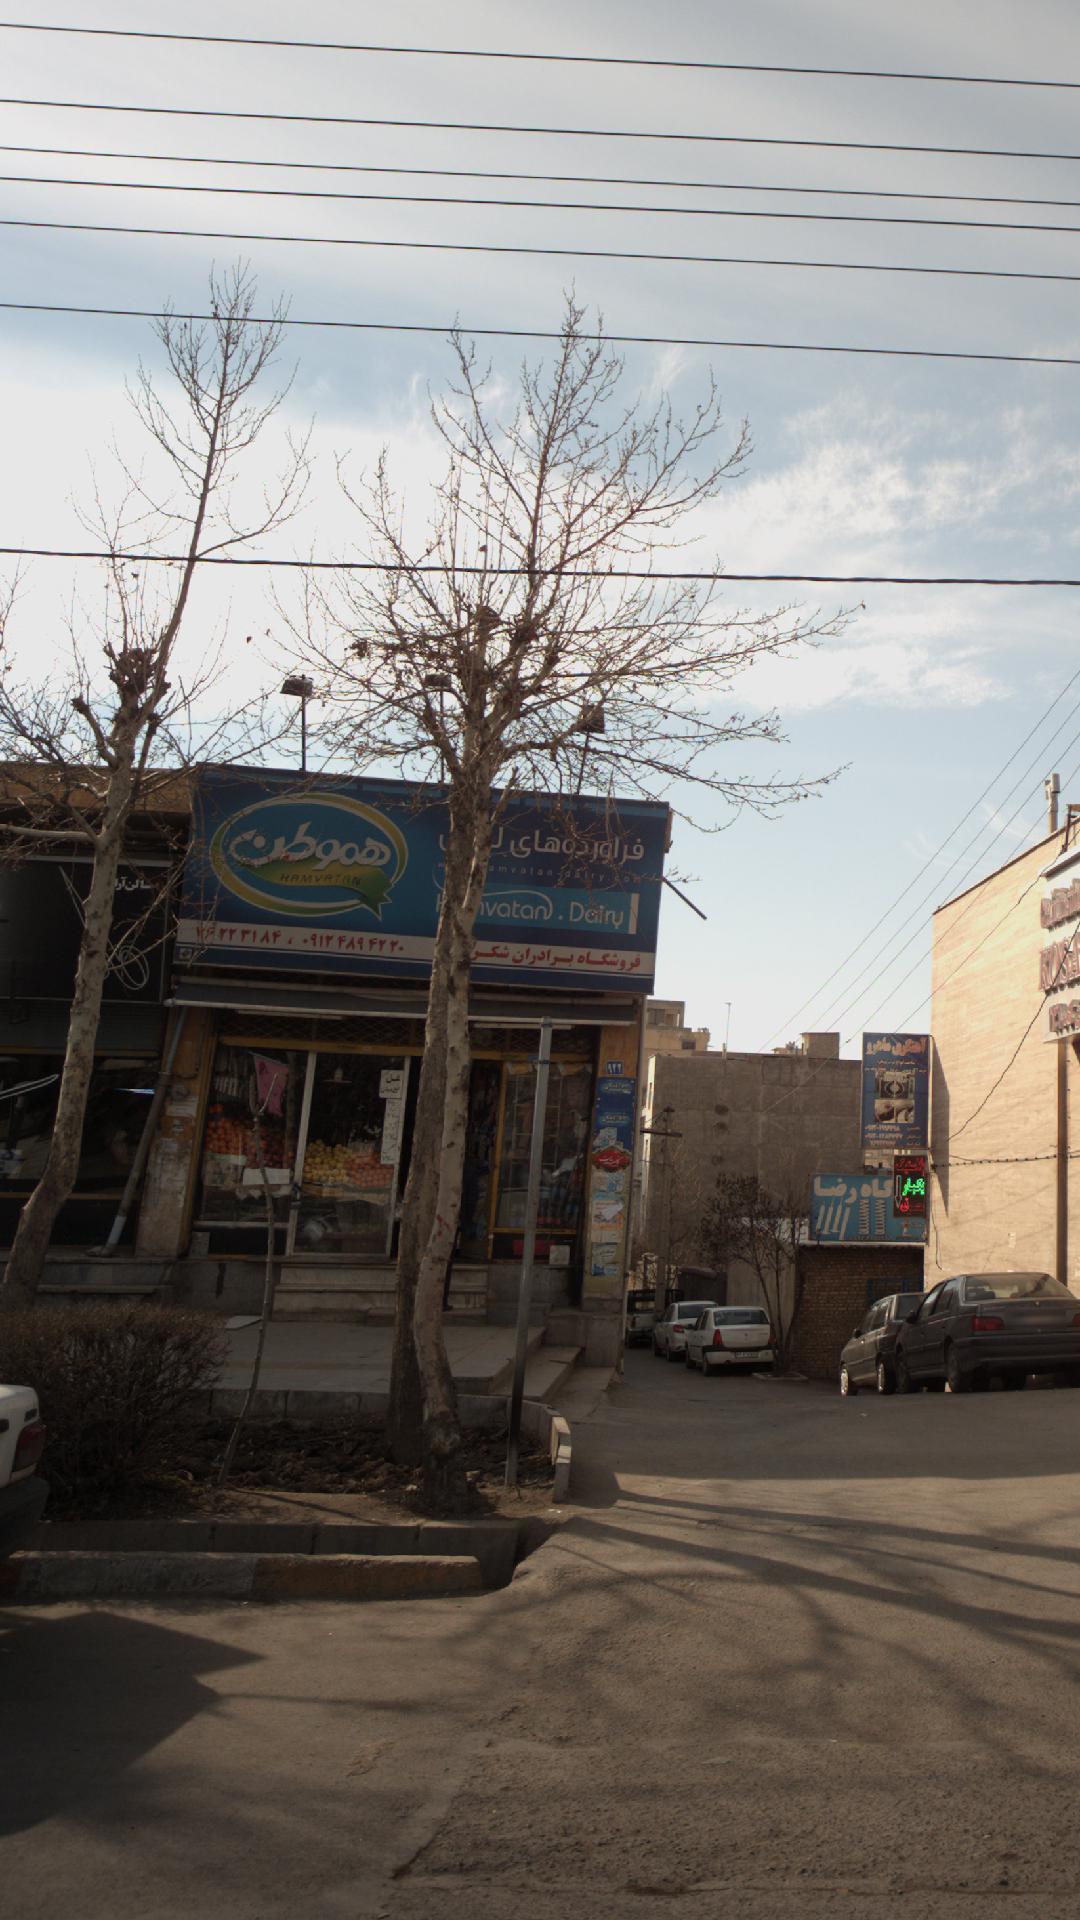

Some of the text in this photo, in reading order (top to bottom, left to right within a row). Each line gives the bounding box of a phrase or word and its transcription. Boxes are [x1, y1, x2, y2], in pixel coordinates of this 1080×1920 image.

[229, 821, 391, 871] هموطن
[569, 901, 624, 929] Dairy
[511, 947, 574, 967] برادران
[577, 950, 641, 970] فروشگاه
[814, 1176, 857, 1207] رضا
